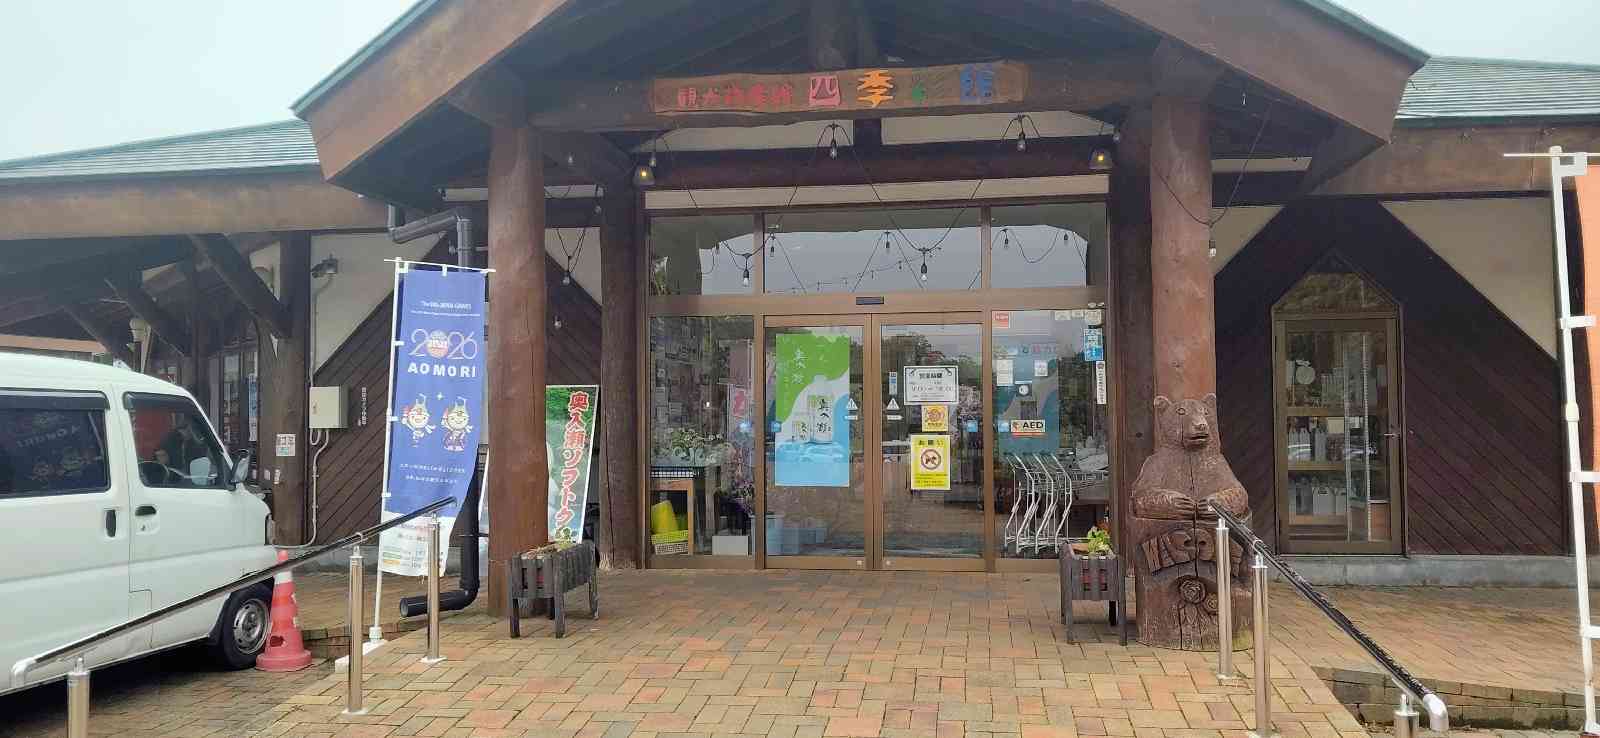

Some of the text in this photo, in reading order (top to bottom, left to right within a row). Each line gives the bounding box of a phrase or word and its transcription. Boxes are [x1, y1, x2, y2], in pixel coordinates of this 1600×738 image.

[408, 328, 478, 360] 2026
[407, 362, 476, 378] AOMORI
[1022, 421, 1043, 429] AED
